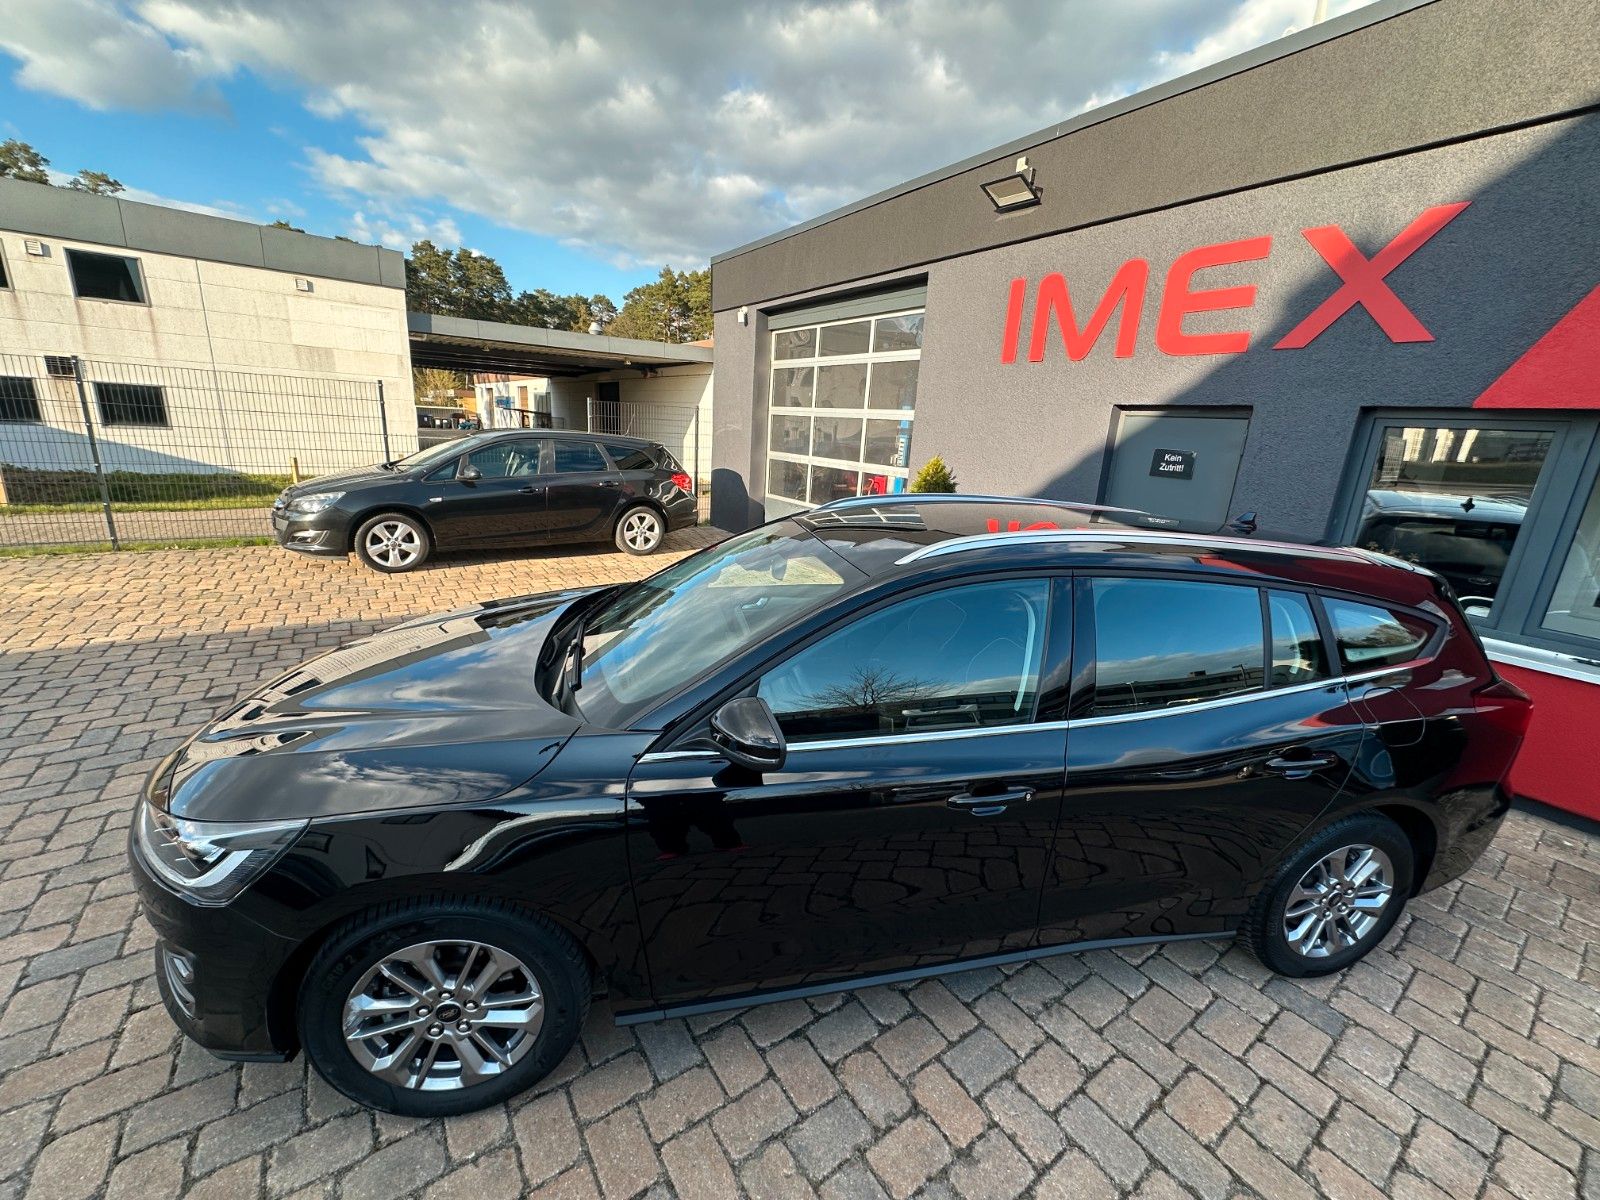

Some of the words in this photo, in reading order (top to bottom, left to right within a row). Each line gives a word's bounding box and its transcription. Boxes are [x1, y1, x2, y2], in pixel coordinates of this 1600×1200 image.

[1001, 200, 1472, 364] IMEX
[1164, 453, 1182, 462] Kein
[1159, 462, 1184, 472] Zutritt!
